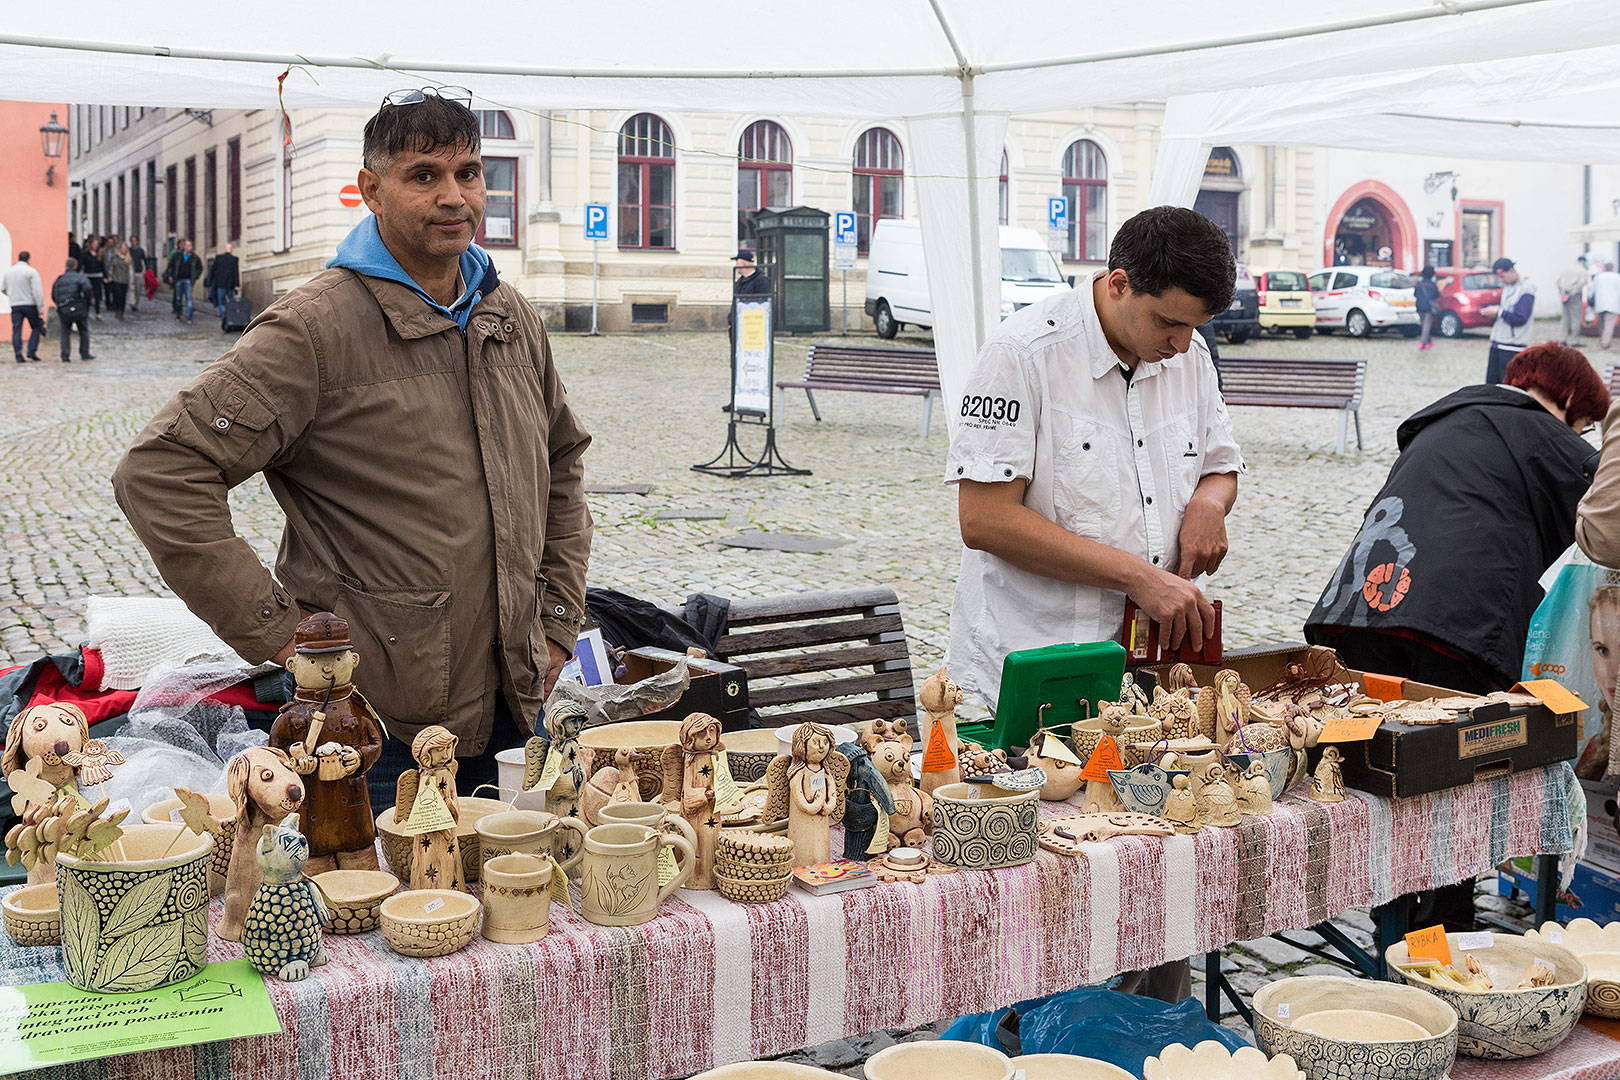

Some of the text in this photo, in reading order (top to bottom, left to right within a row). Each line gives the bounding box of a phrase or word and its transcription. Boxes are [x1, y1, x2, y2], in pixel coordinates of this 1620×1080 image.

[589, 207, 605, 229] P
[1051, 200, 1064, 220] P
[838, 215, 853, 235] P
[960, 395, 1021, 422] 82030
[1541, 663, 1566, 675] coop
[1465, 720, 1521, 743] MEDIFRESH
[1408, 932, 1439, 949] RYBKA
[66, 997, 158, 1015] přispíváte
[106, 1005, 149, 1017] osob
[123, 1006, 224, 1027] postižením
